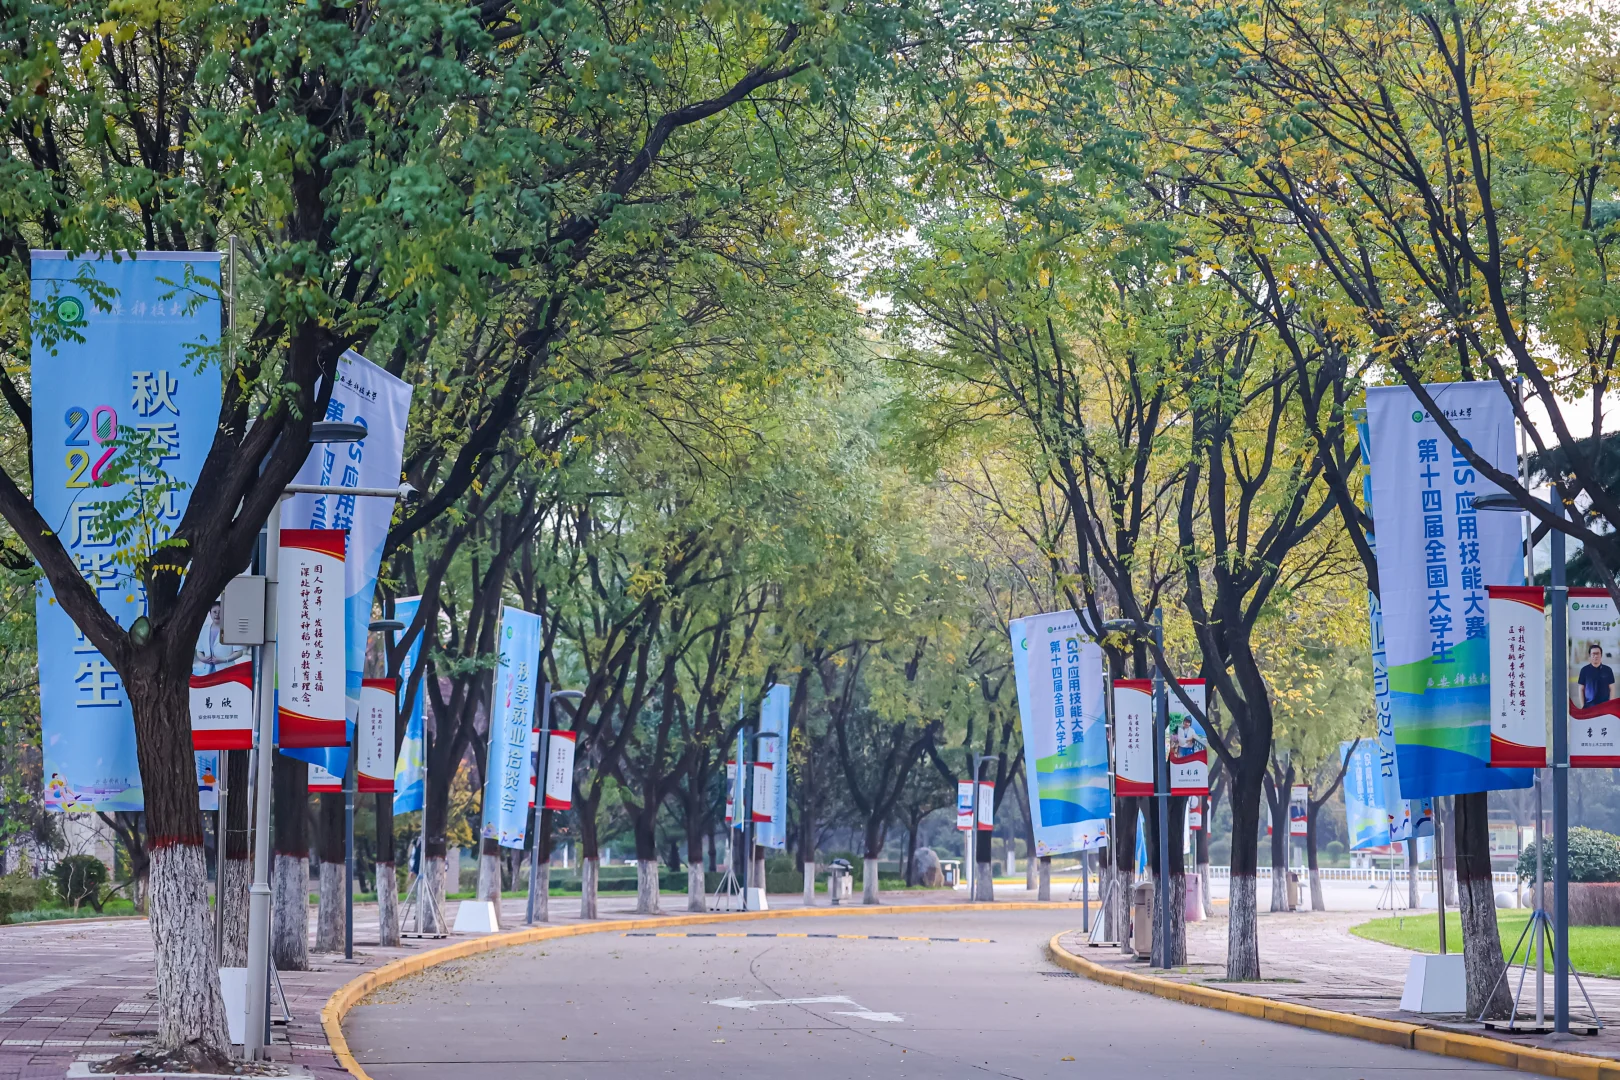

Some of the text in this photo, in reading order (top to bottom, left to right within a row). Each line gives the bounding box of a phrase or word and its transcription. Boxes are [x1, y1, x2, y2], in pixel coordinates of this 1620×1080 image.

[1424, 407, 1472, 419] 西科技大学
[1418, 438, 1456, 665] 第十四届全国大学生
[205, 696, 232, 708] 易欣
[502, 661, 530, 814] 秋季就业洽谈会
[1049, 640, 1067, 757] 第十四届全国大学生
